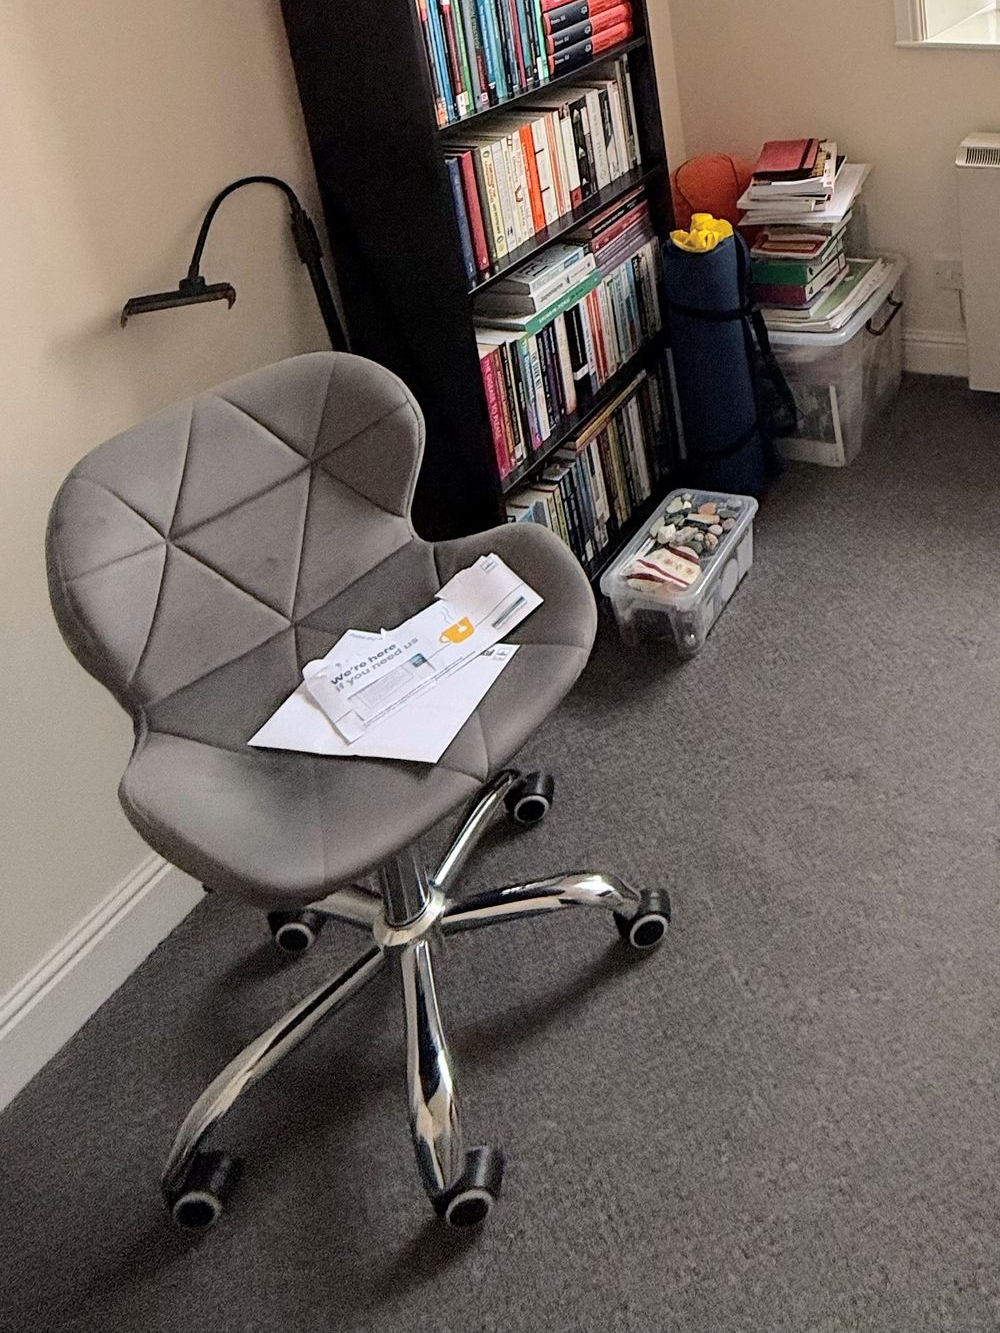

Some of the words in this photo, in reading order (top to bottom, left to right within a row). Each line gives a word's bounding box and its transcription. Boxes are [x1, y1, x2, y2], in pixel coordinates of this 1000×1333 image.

[330, 662, 367, 685] We're
[367, 644, 397, 663] here
[346, 670, 371, 686] you
[372, 648, 403, 671] need
[403, 637, 419, 650] us
